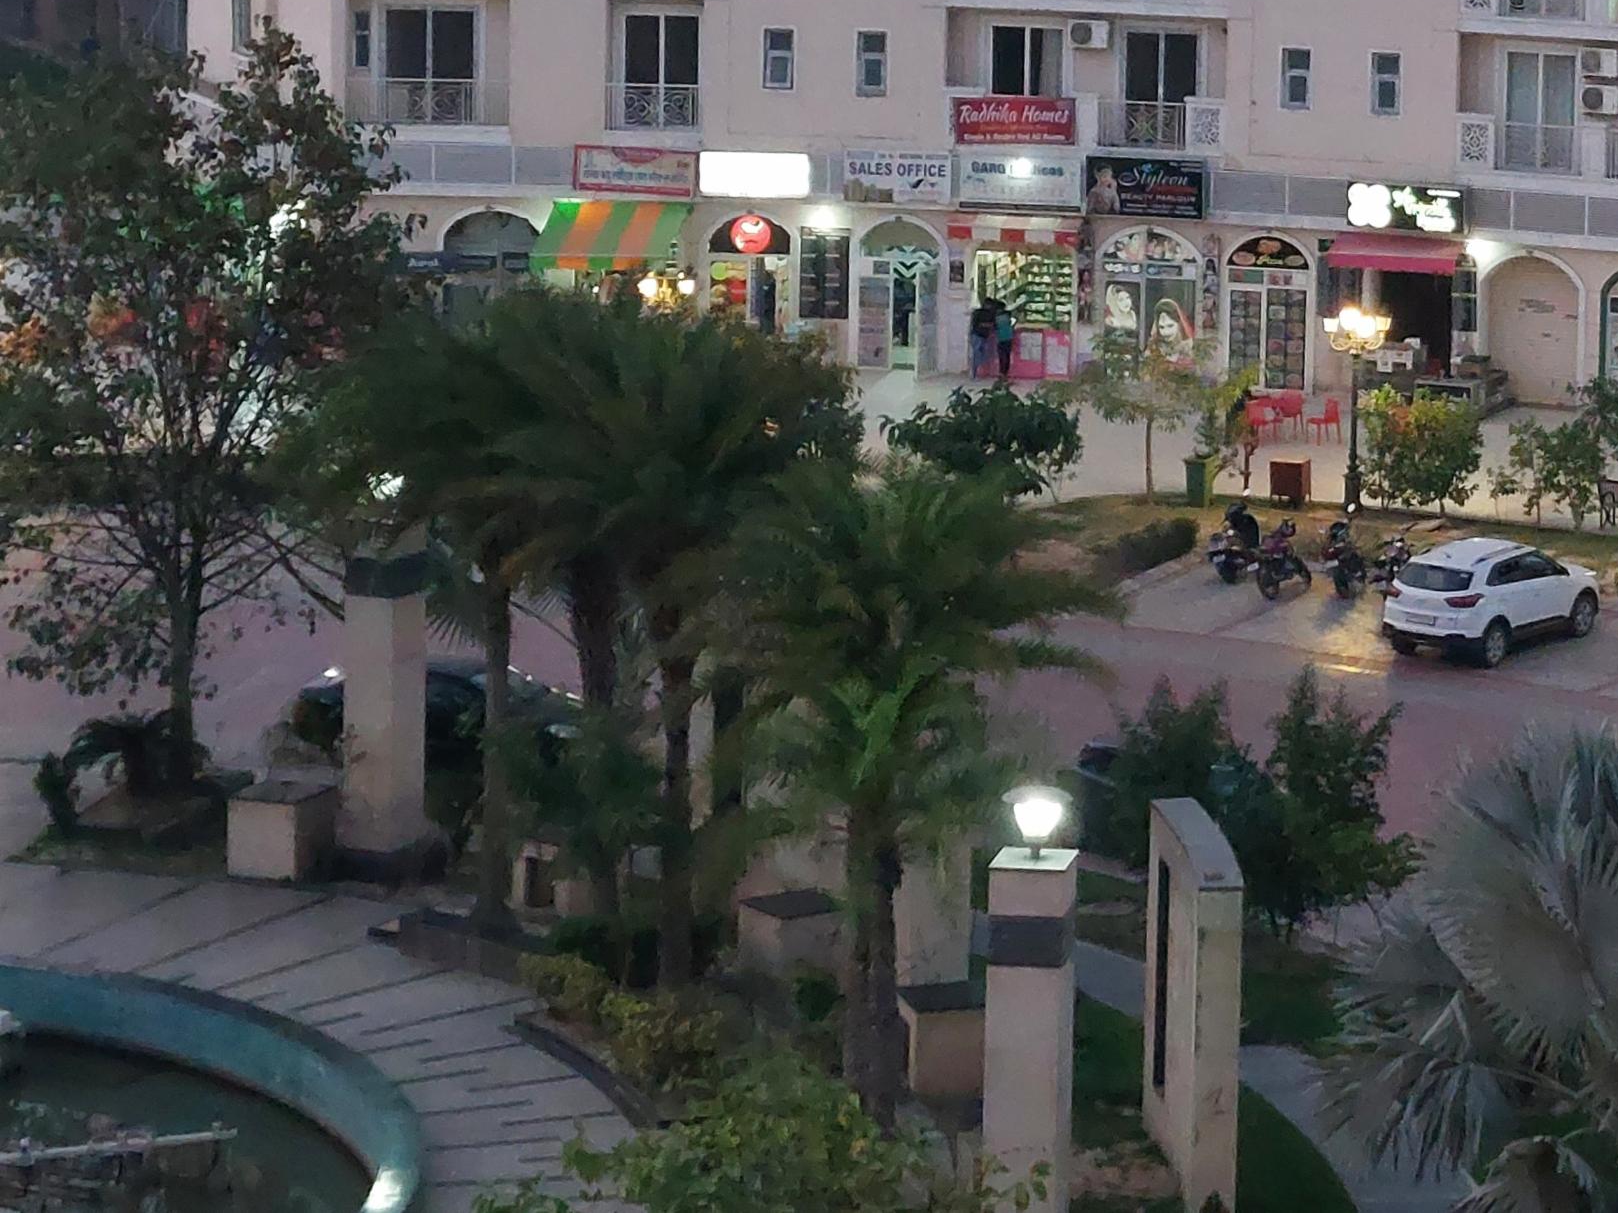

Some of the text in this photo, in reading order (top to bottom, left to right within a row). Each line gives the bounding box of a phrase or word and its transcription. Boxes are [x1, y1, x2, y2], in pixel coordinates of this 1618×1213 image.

[959, 102, 1070, 124] Radhika Homes
[849, 162, 947, 177] SALES OFFICE
